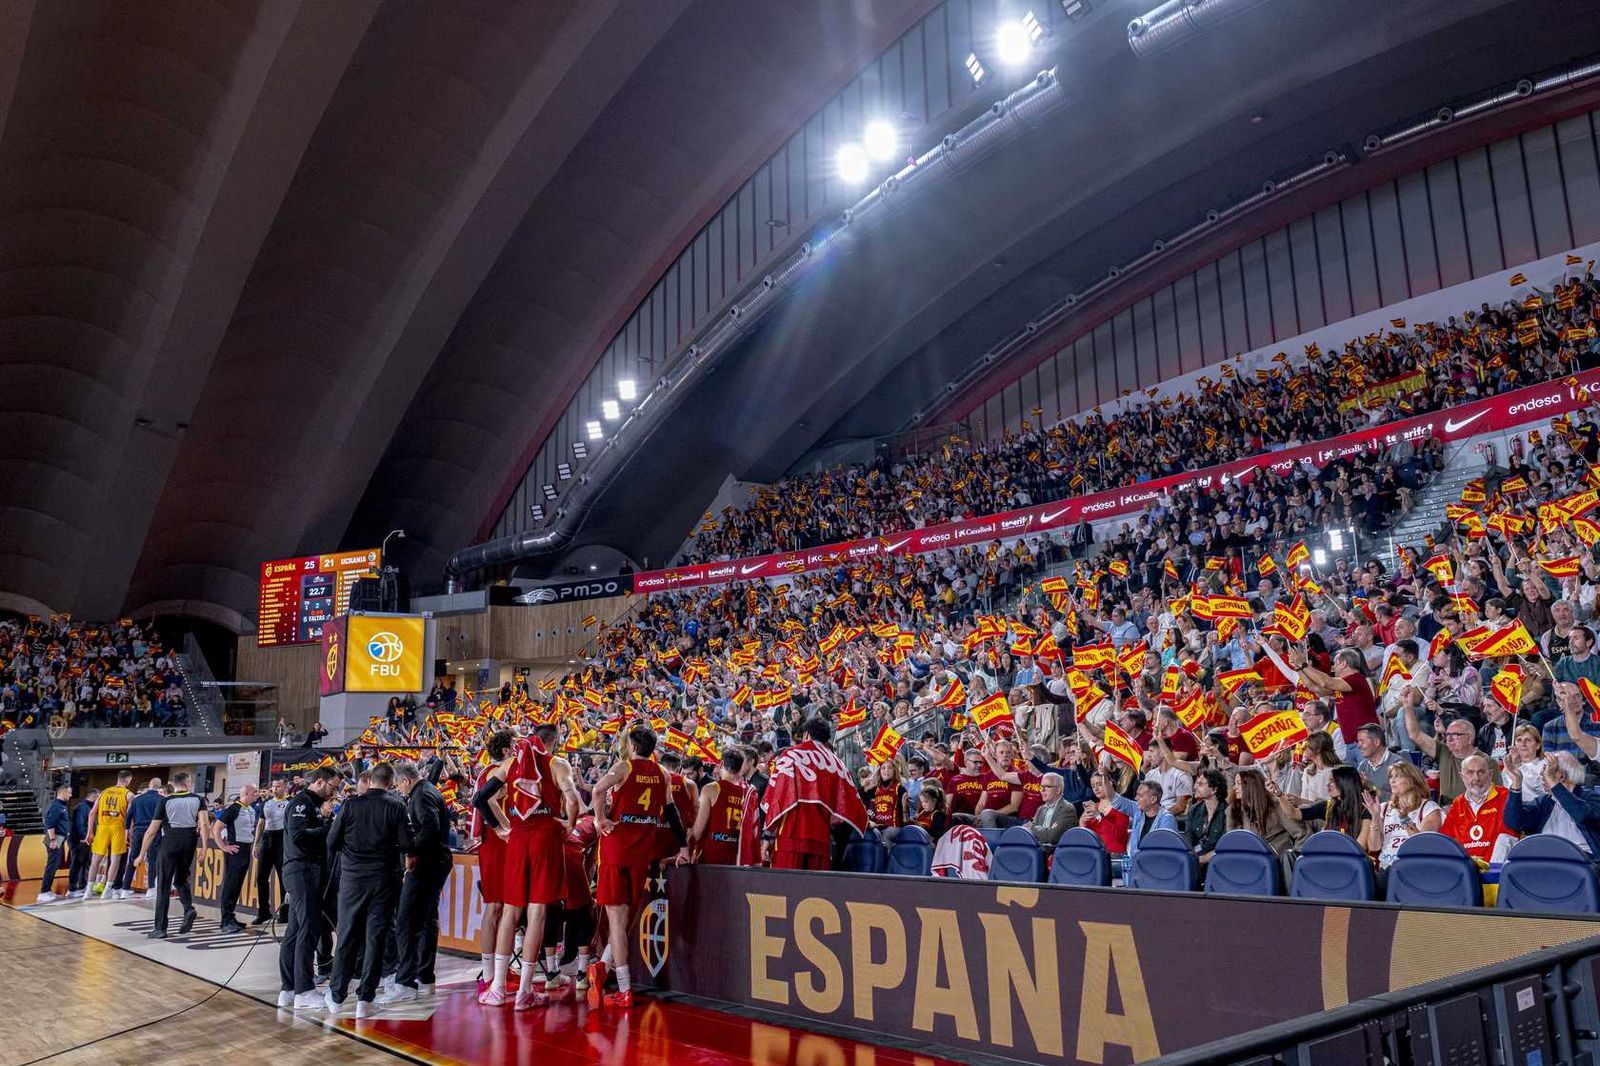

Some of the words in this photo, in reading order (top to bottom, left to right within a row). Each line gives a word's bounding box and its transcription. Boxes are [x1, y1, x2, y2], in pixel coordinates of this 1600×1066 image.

[1508, 393, 1561, 415] endesa
[1081, 500, 1116, 514] endesa
[966, 525, 993, 536] CaixaBank
[920, 533, 950, 545] endesa
[304, 561, 315, 570] 25
[324, 559, 334, 568] 21
[340, 556, 366, 565] UCRANIA
[274, 563, 296, 573] ESPAÑA
[309, 587, 325, 596] 22.7
[370, 664, 400, 676] FBU
[163, 729, 176, 738] FS
[180, 729, 188, 738] 5
[1250, 716, 1297, 750] ESPAÑA
[637, 787, 652, 811] 4
[876, 803, 888, 813] 35
[1463, 840, 1491, 849] vodafone
[745, 886, 1162, 1065] ESPAÑA
